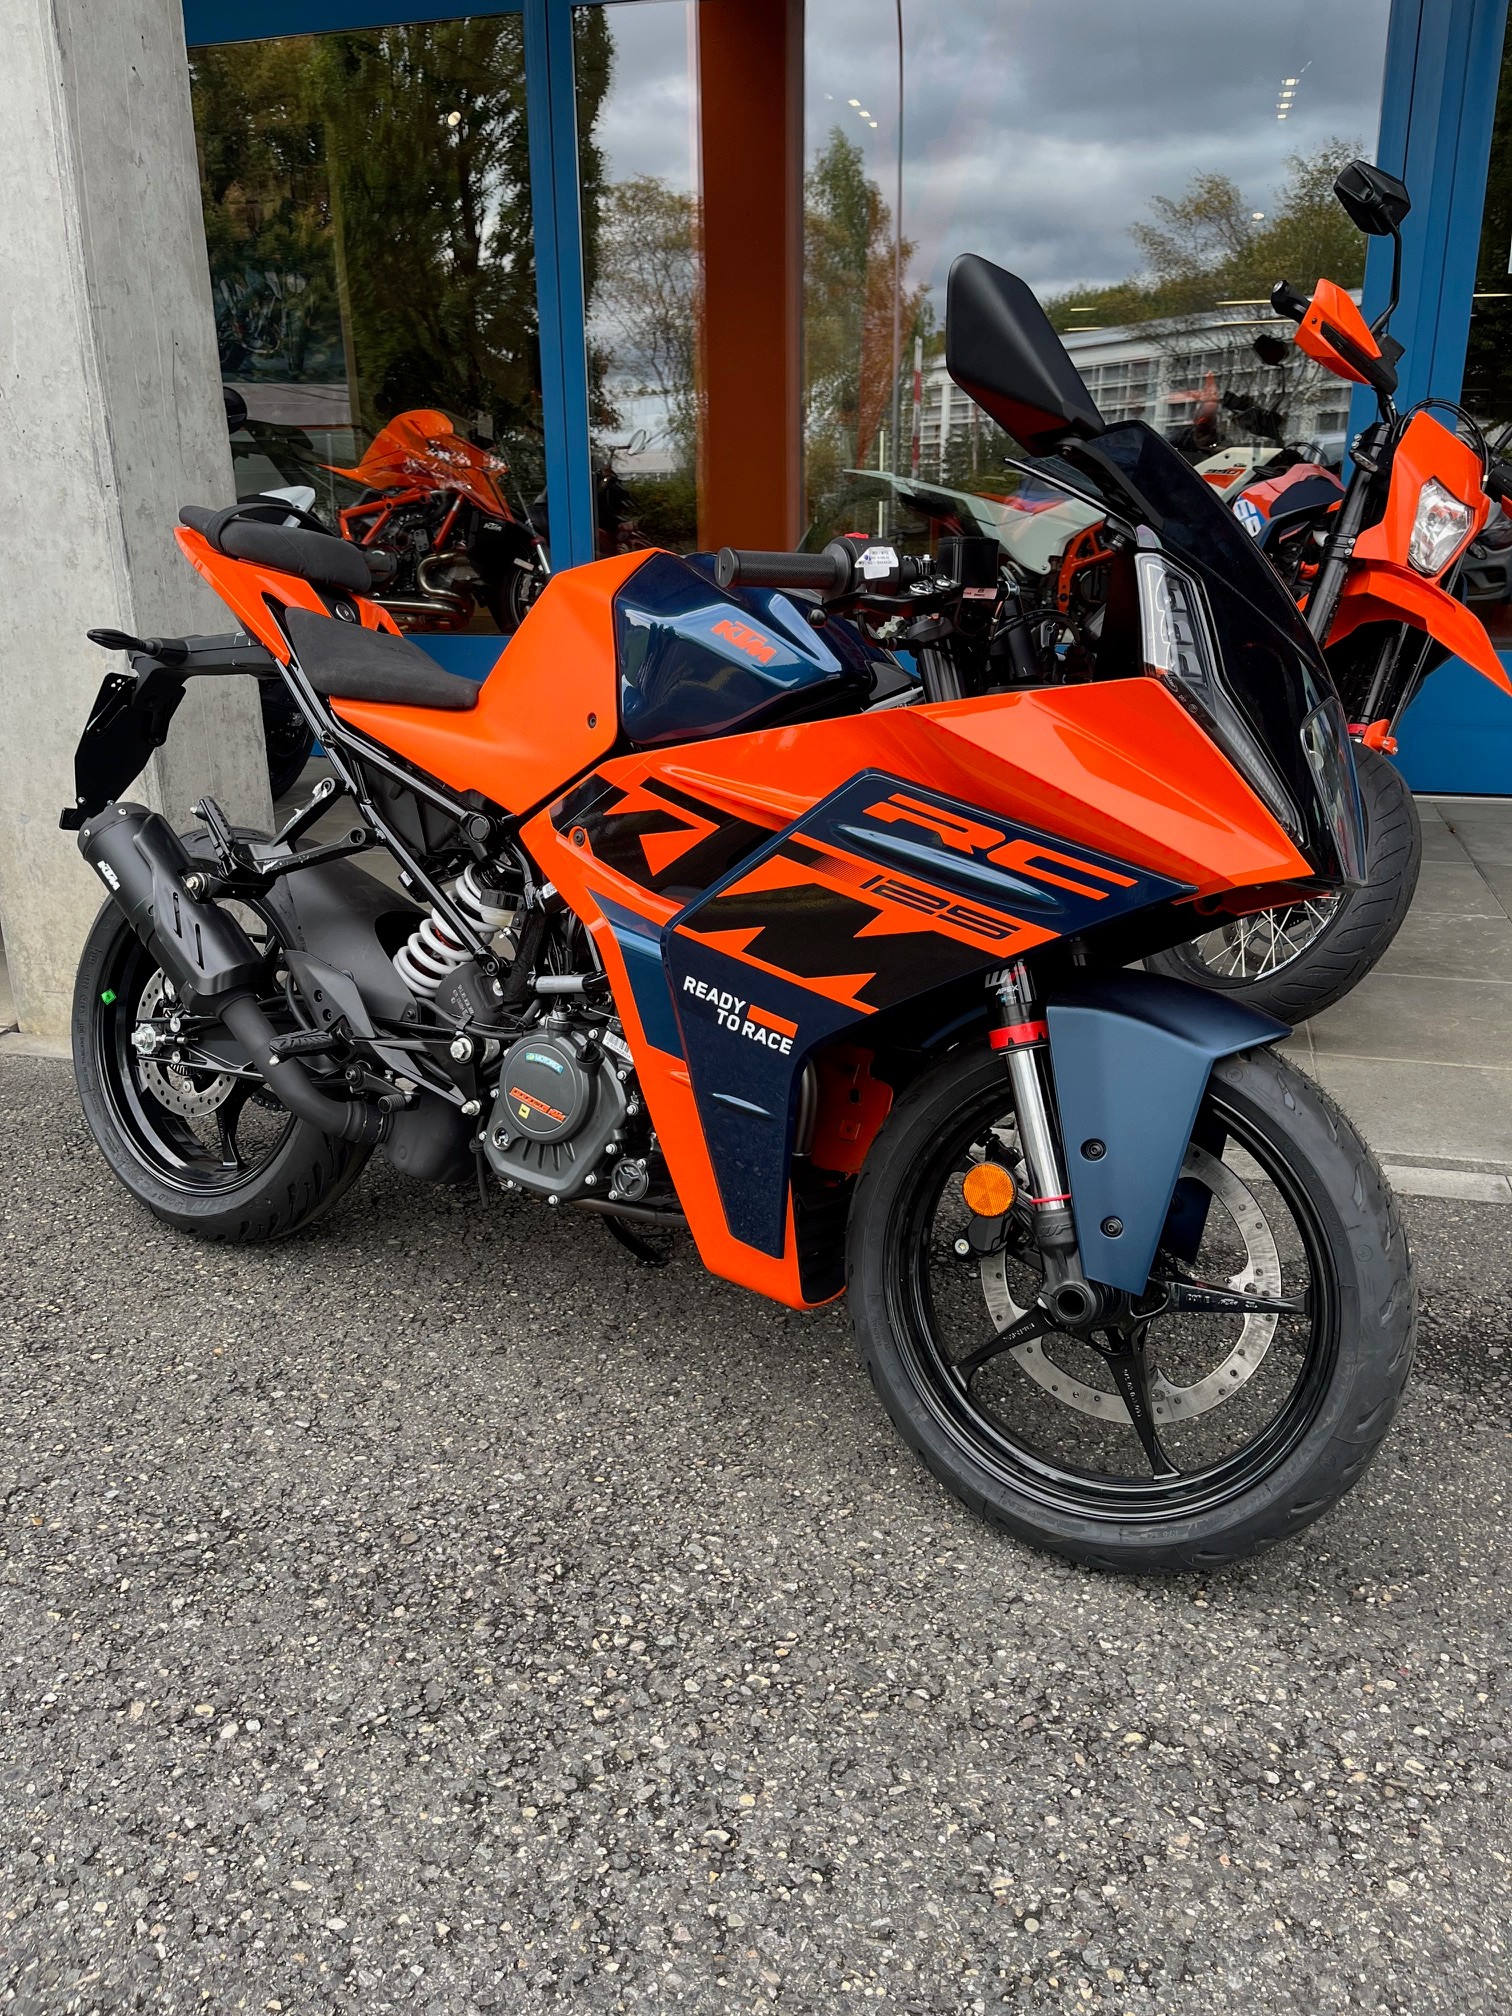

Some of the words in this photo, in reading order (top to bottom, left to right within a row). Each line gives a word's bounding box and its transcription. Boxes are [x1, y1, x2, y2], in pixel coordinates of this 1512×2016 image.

[711, 619, 777, 664] KTM
[862, 793, 1139, 901] RC
[97, 860, 120, 890] KTM
[859, 874, 1022, 940] 125
[683, 975, 747, 1014] READY
[995, 984, 1019, 996] APEX
[717, 1008, 741, 1031] TO
[741, 1020, 794, 1055] RACE
